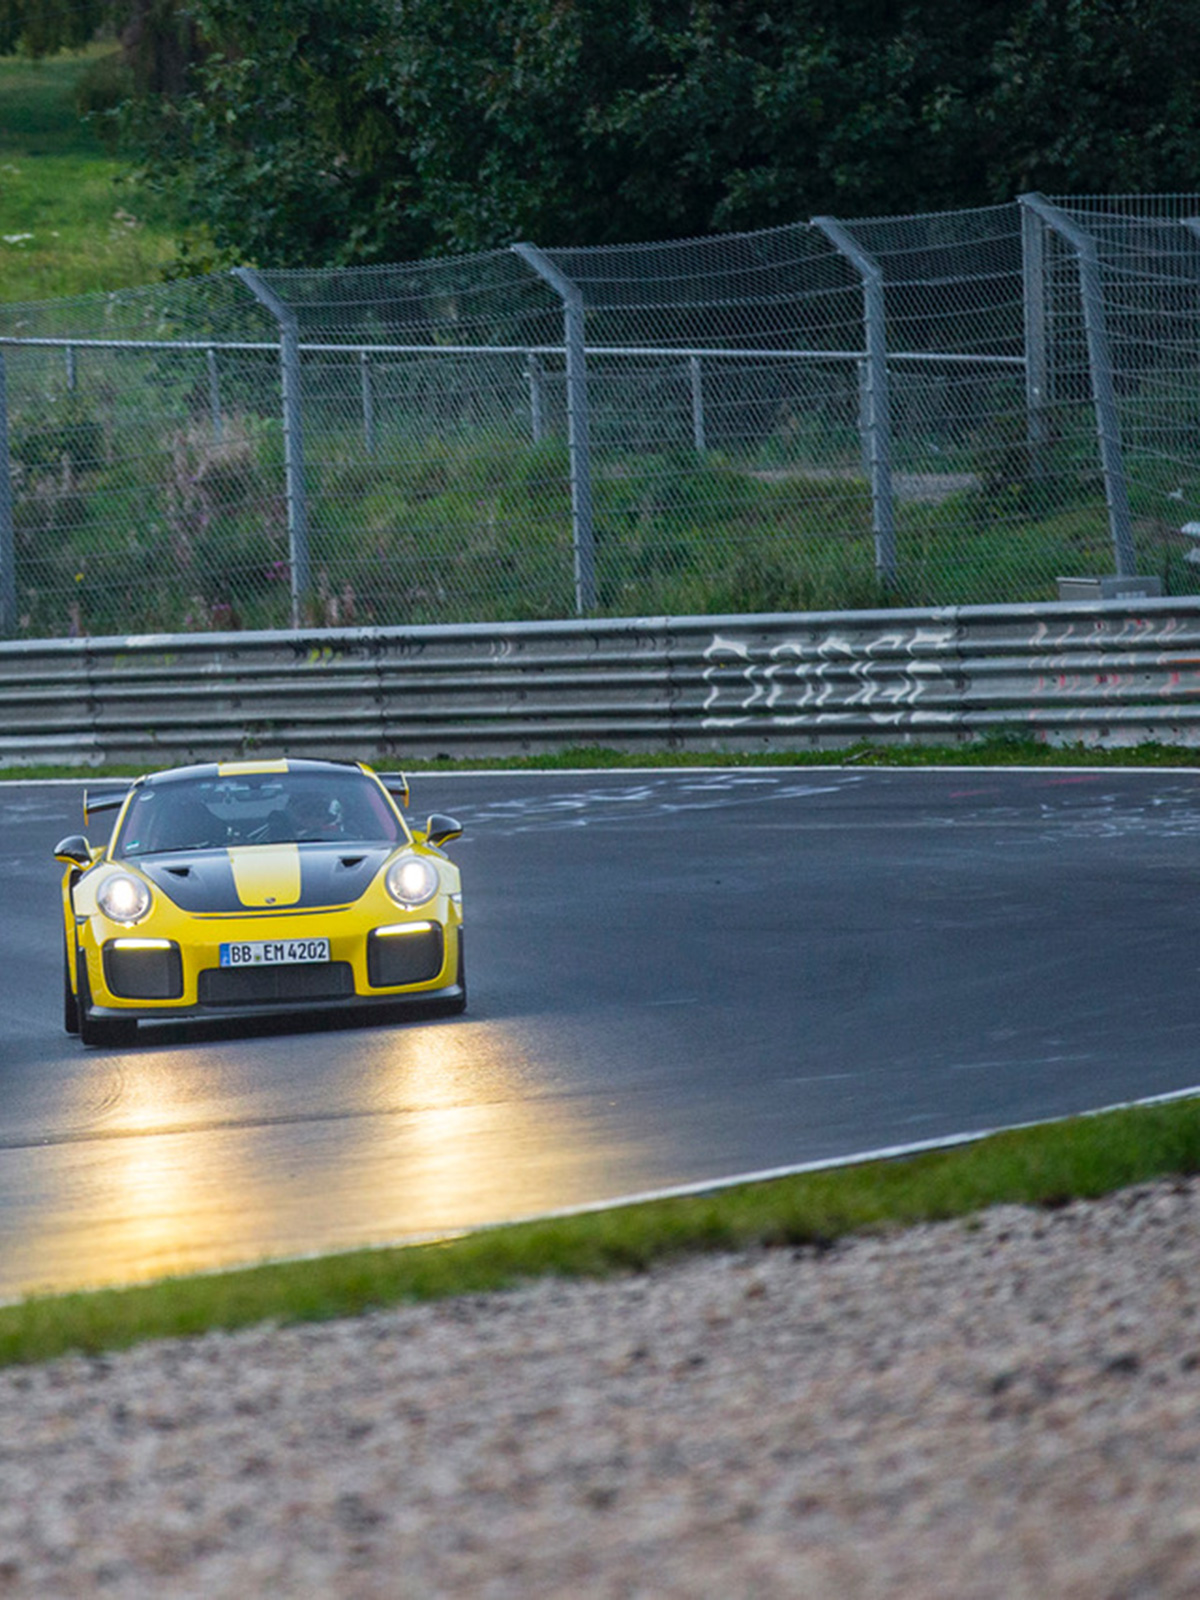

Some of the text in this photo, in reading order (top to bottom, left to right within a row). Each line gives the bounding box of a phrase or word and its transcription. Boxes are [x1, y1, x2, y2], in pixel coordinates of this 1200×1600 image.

[231, 945, 252, 963] BB
[263, 943, 284, 961] EM
[288, 941, 326, 960] 4202
